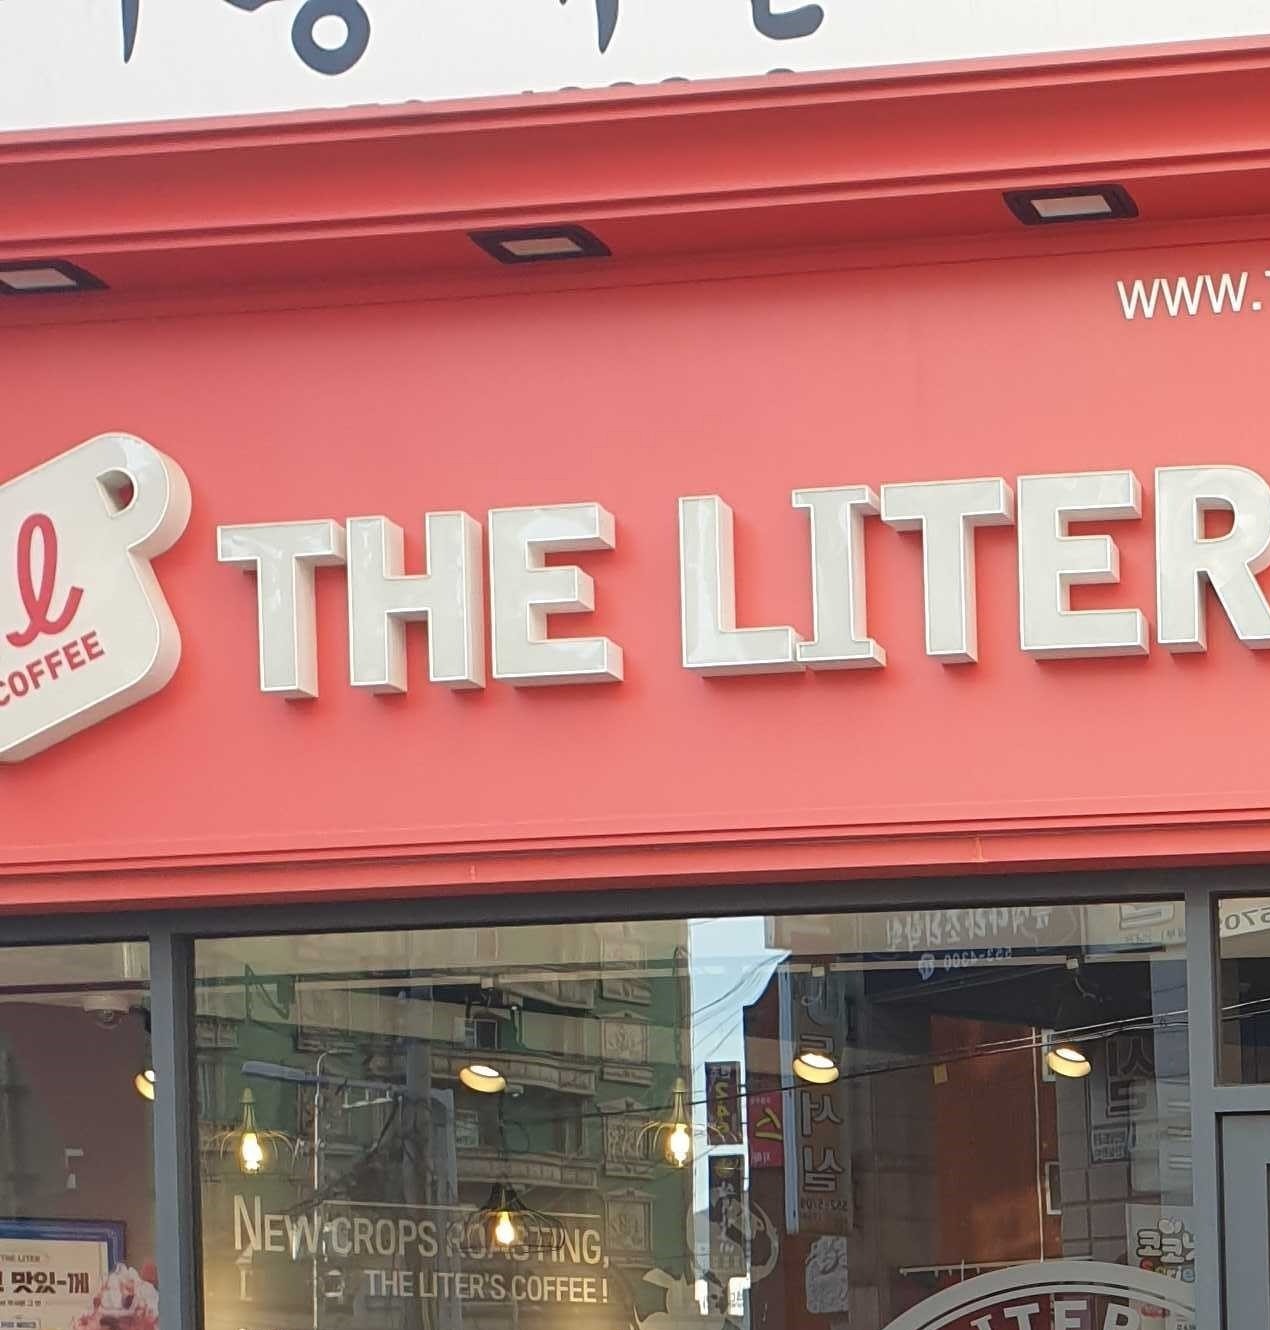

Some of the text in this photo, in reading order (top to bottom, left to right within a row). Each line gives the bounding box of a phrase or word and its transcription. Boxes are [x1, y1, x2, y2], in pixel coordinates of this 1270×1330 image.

[216, 502, 624, 699] THE
[332, 1217, 438, 1258] CROPS
[363, 1269, 414, 1297] THE
[419, 1271, 506, 1300] LITER'S
